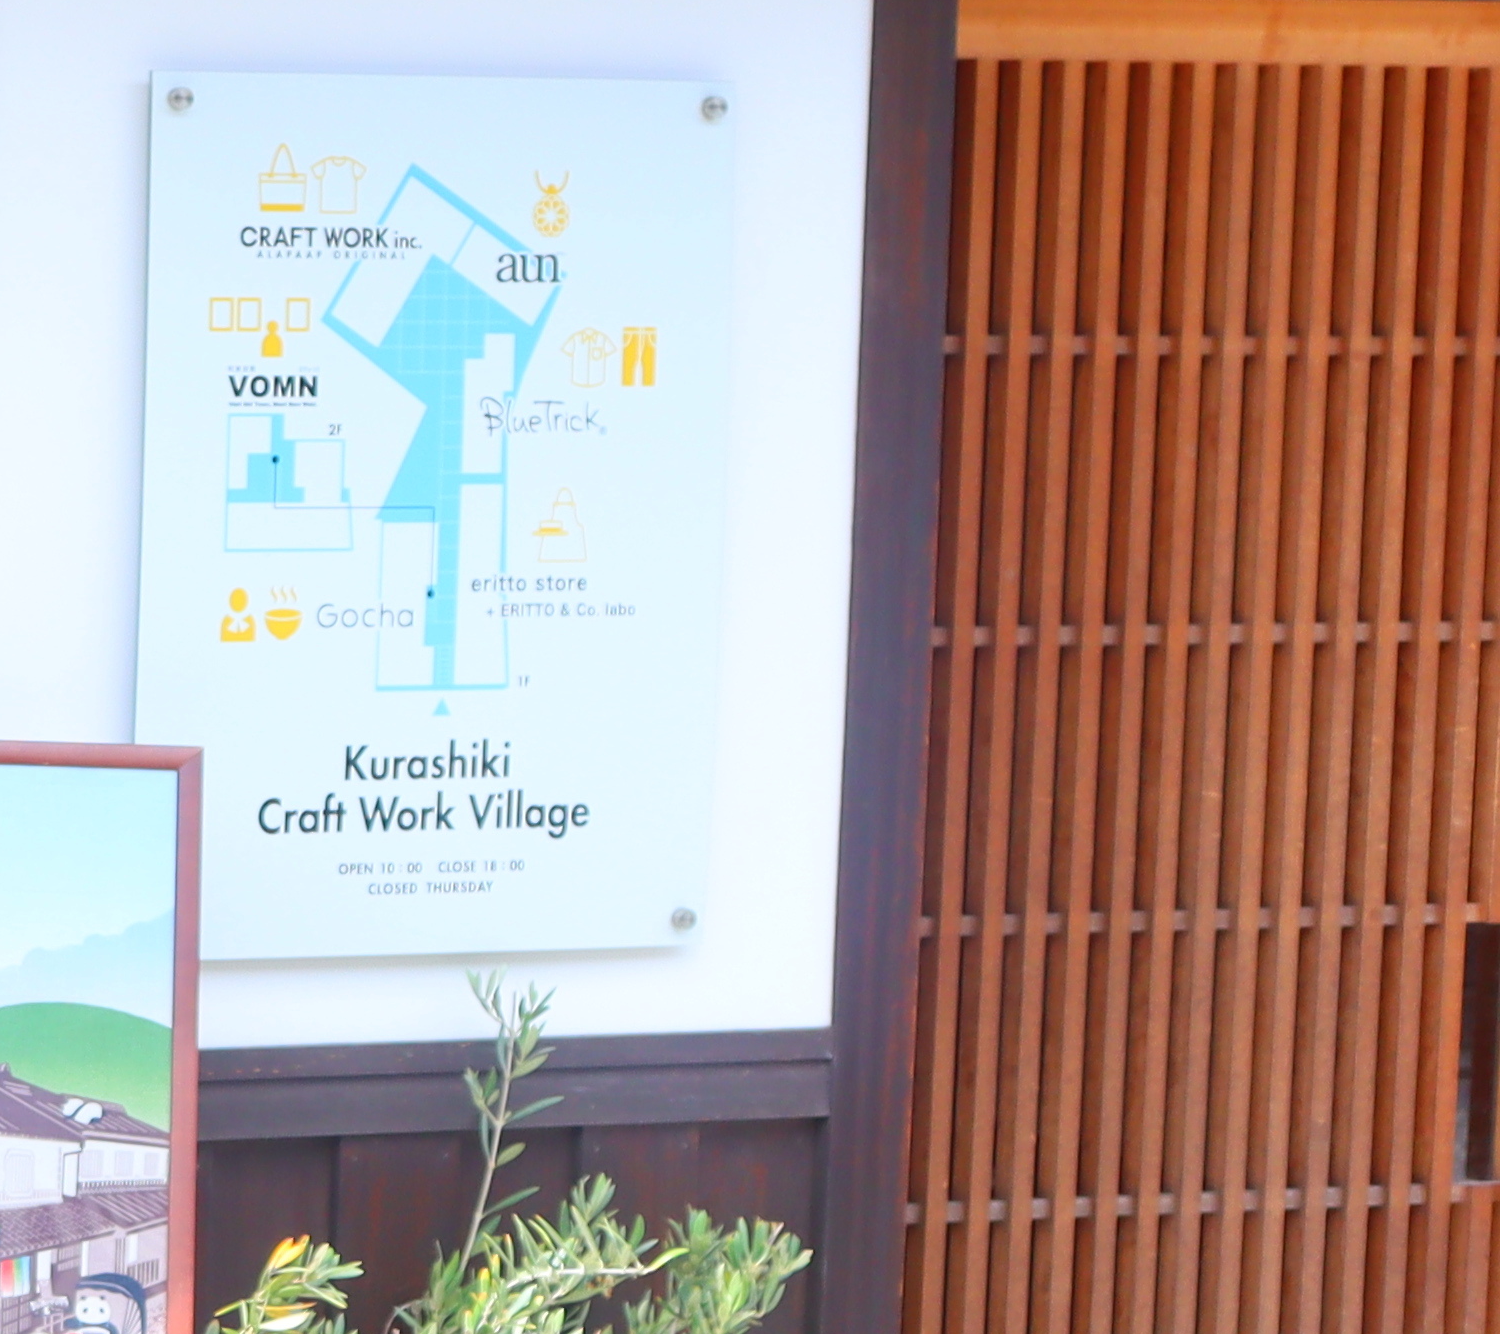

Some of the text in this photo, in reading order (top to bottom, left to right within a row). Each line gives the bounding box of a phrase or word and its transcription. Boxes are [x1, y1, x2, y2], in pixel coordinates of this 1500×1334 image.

[240, 226, 422, 249] CRAFT WORK inc.
[334, 250, 405, 259] ORIGINAL
[496, 253, 560, 283] aun
[228, 375, 317, 397] VOMN
[329, 424, 342, 436] 2F
[471, 575, 587, 593] eritto store
[316, 603, 415, 628] Gocha
[501, 603, 555, 617] ERITTO
[560, 603, 570, 617] &
[576, 603, 600, 617] Co.
[605, 602, 636, 616] labo
[518, 675, 530, 688] 1F
[344, 739, 511, 781] Kurashiki
[258, 788, 590, 839] Craft Work Village
[338, 863, 373, 875] OPEN
[438, 861, 476, 874] CLOSE
[368, 880, 494, 896] CLOSED THURSDAY
